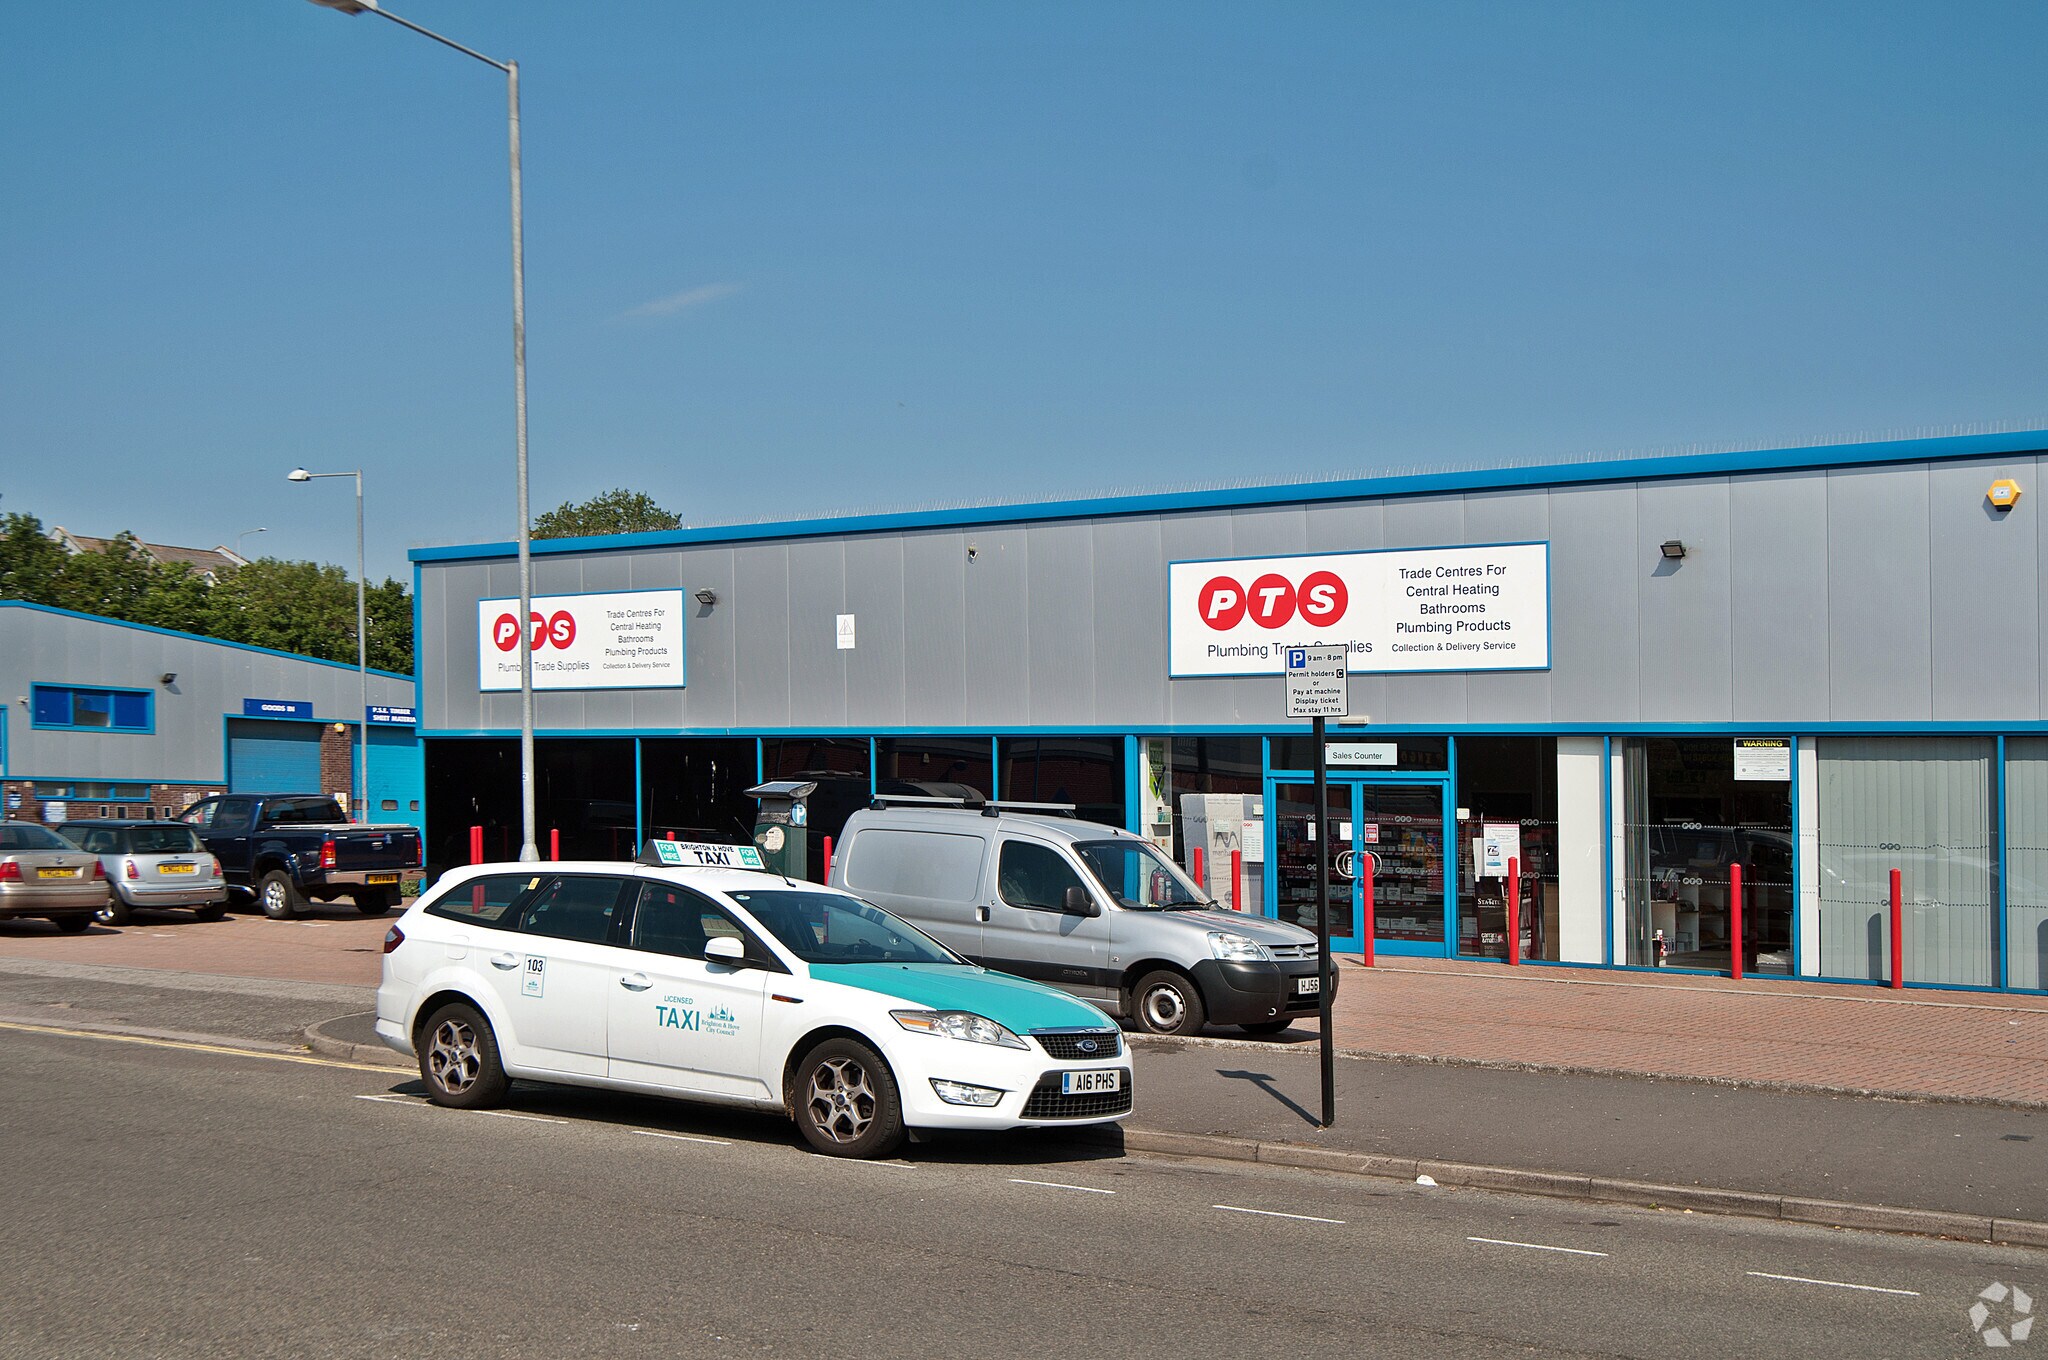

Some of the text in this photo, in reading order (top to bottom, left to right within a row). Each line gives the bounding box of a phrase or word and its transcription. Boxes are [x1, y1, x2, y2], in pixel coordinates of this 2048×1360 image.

[1399, 564, 1507, 580] Trade Centres For
[1406, 583, 1500, 599] Central Heating
[1204, 580, 1340, 622] PTS
[1420, 602, 1486, 615] Bathrooms
[607, 609, 665, 619] Trade Centres For
[611, 622, 662, 631] Central Heating
[1396, 620, 1511, 637] Plumbing Products
[618, 635, 653, 643] Bathrooms
[606, 647, 668, 657] Plumbing Products
[1207, 644, 1268, 660] Plumbing
[1391, 641, 1516, 654] Collection & Delivery Service
[1293, 652, 1303, 667] P
[498, 661, 590, 673] Plumb Trade Supplies
[632, 662, 651, 670] Delivery
[262, 704, 286, 712] GOODS
[1354, 752, 1382, 760] Counter
[660, 843, 676, 852] FOR
[680, 843, 711, 852] BRIGHTON
[663, 852, 680, 860] HIRE
[694, 851, 731, 865] TAXI
[741, 849, 756, 857] FOR
[743, 857, 760, 865] HIRE
[527, 958, 544, 972] 103
[1301, 979, 1319, 991] HJ56
[664, 995, 694, 1005] LICENSED
[656, 1006, 700, 1032] TAXI
[701, 1019, 722, 1028] Brighton
[706, 1027, 735, 1036] City Council
[1076, 1073, 1114, 1091] A16 PHS
